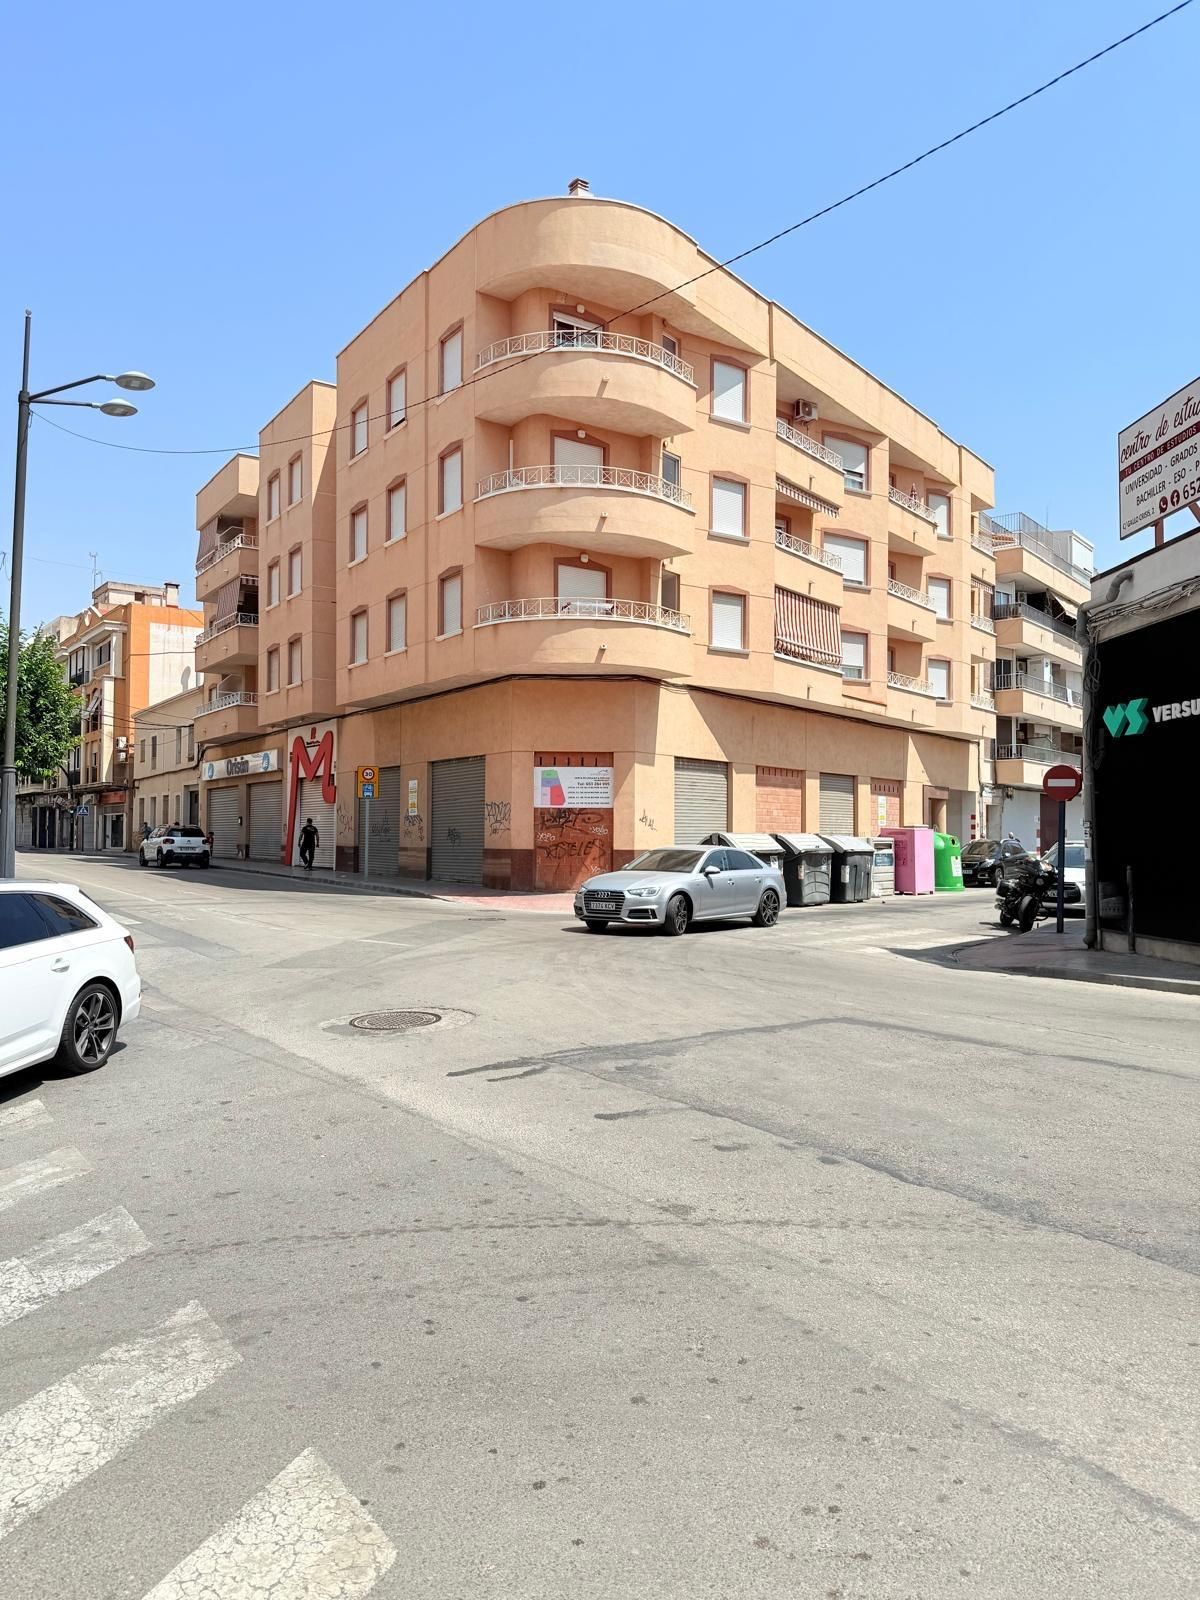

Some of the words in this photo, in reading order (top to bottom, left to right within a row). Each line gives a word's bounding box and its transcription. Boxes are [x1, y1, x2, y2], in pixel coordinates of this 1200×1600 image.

[1121, 430, 1151, 463] centro
[1155, 413, 1169, 441] de
[1124, 467, 1132, 476] TU
[1133, 451, 1155, 470] CENTRO
[1156, 444, 1165, 456] DE
[1166, 425, 1197, 450] ESTUDIOS
[1125, 464, 1162, 495] UNIVERSIDAD
[1170, 443, 1198, 467] GRADOS
[1136, 480, 1166, 506] BACHILLER
[1174, 467, 1187, 484] ESO
[1152, 698, 1200, 723] VERSU
